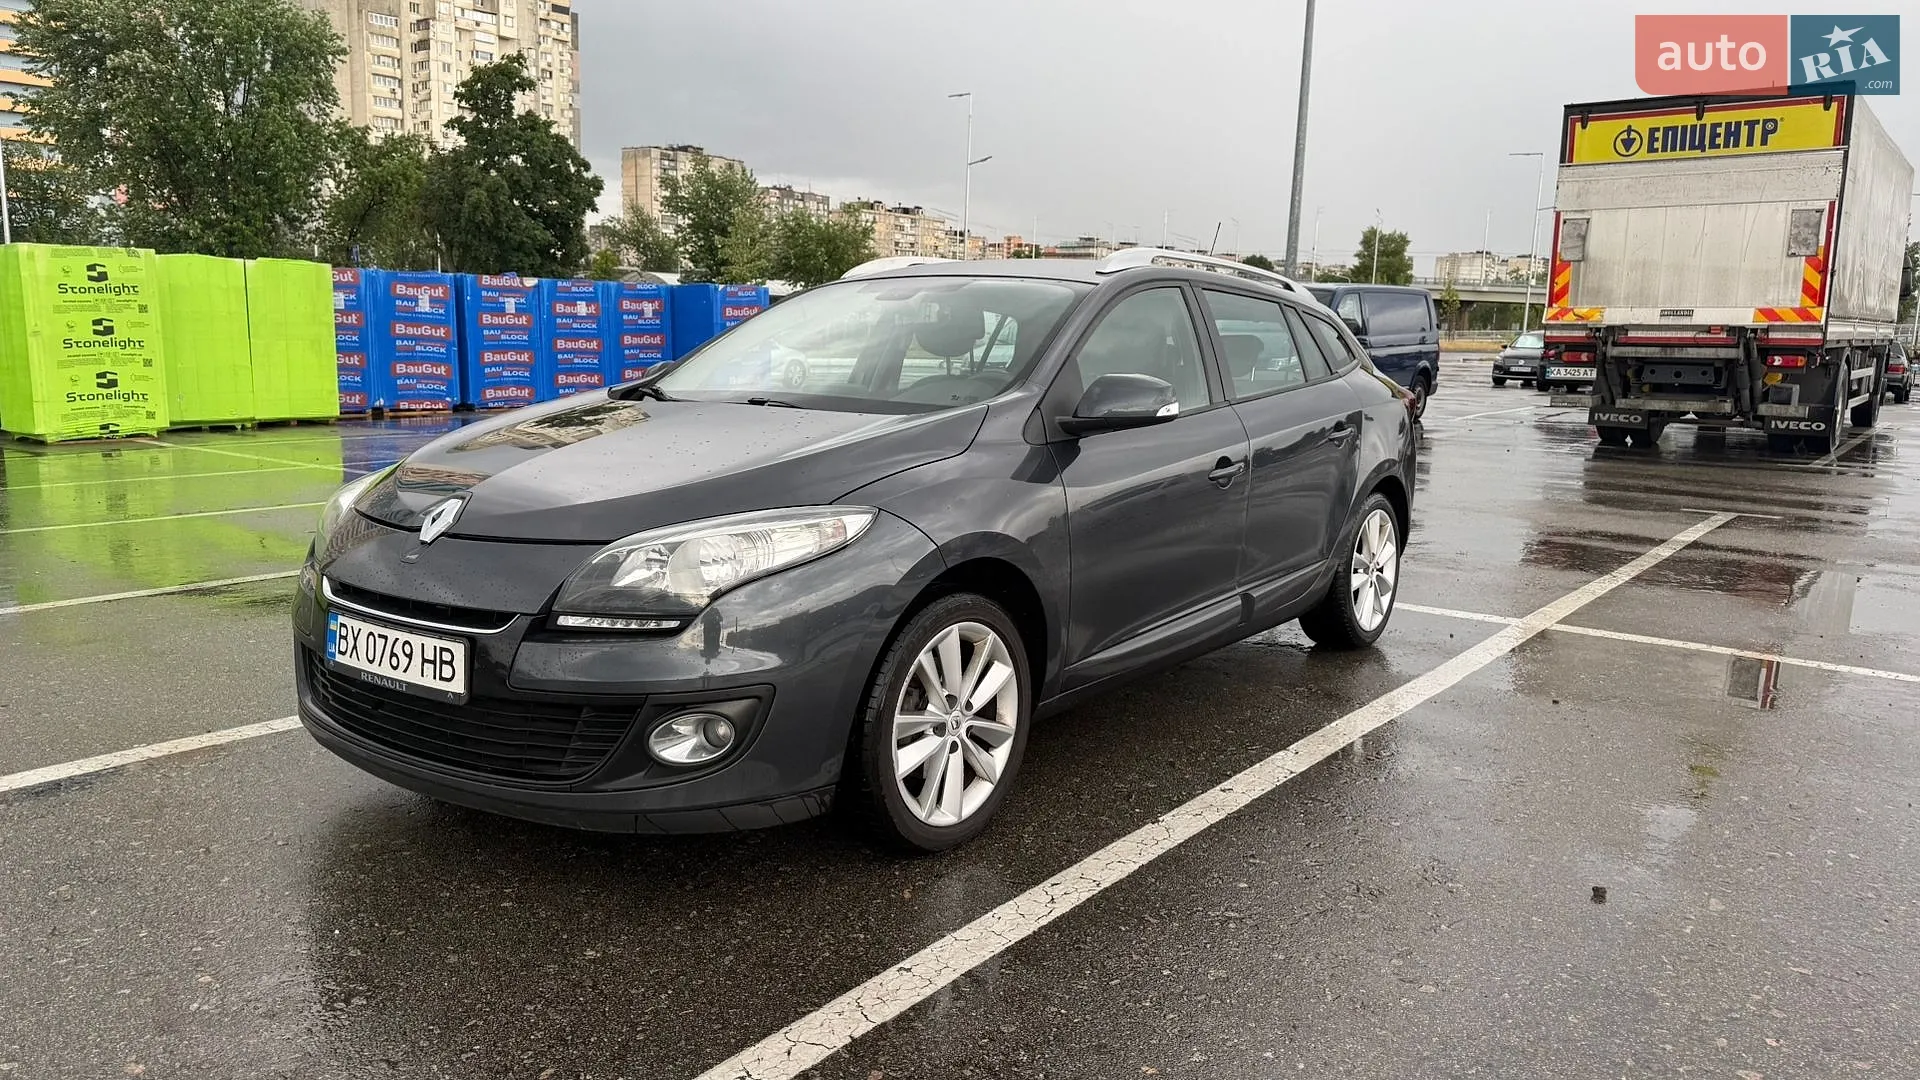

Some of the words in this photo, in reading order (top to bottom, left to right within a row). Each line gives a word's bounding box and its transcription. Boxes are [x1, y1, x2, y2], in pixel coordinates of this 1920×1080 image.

[1646, 118, 1779, 154] ЕПІЦЕНТР
[332, 270, 355, 281] Gut
[481, 275, 523, 287] BauGut
[57, 283, 139, 296] Stonelight
[396, 284, 445, 297] BauGut
[481, 290, 499, 298] BAU
[395, 299, 415, 307] BAU
[556, 303, 596, 314] Bauut
[335, 312, 359, 324] Gut
[482, 314, 528, 325] BauGut
[395, 323, 446, 337] BauGut
[62, 337, 144, 350] Stonelight
[337, 334, 360, 342] OCK
[623, 335, 662, 345] BauGut
[415, 345, 446, 353] BLOCK
[556, 339, 598, 350] BauGut
[337, 354, 361, 365] Gut
[483, 352, 530, 362] BauGut
[396, 363, 447, 376] BauGut
[1550, 367, 1561, 376] KA
[1563, 368, 1581, 377] 3425
[1582, 368, 1594, 377] AT
[558, 374, 600, 384] BauGut
[416, 383, 447, 391] BLOCK
[66, 390, 149, 402] Stonelight
[485, 387, 530, 399] BauGut
[339, 394, 361, 404] Gut
[1594, 412, 1643, 423] IVECO
[1771, 420, 1826, 431] IVECO
[338, 621, 361, 662] BX
[365, 631, 413, 674] 0769
[420, 642, 456, 683] HB
[360, 671, 408, 692] RENAULT
